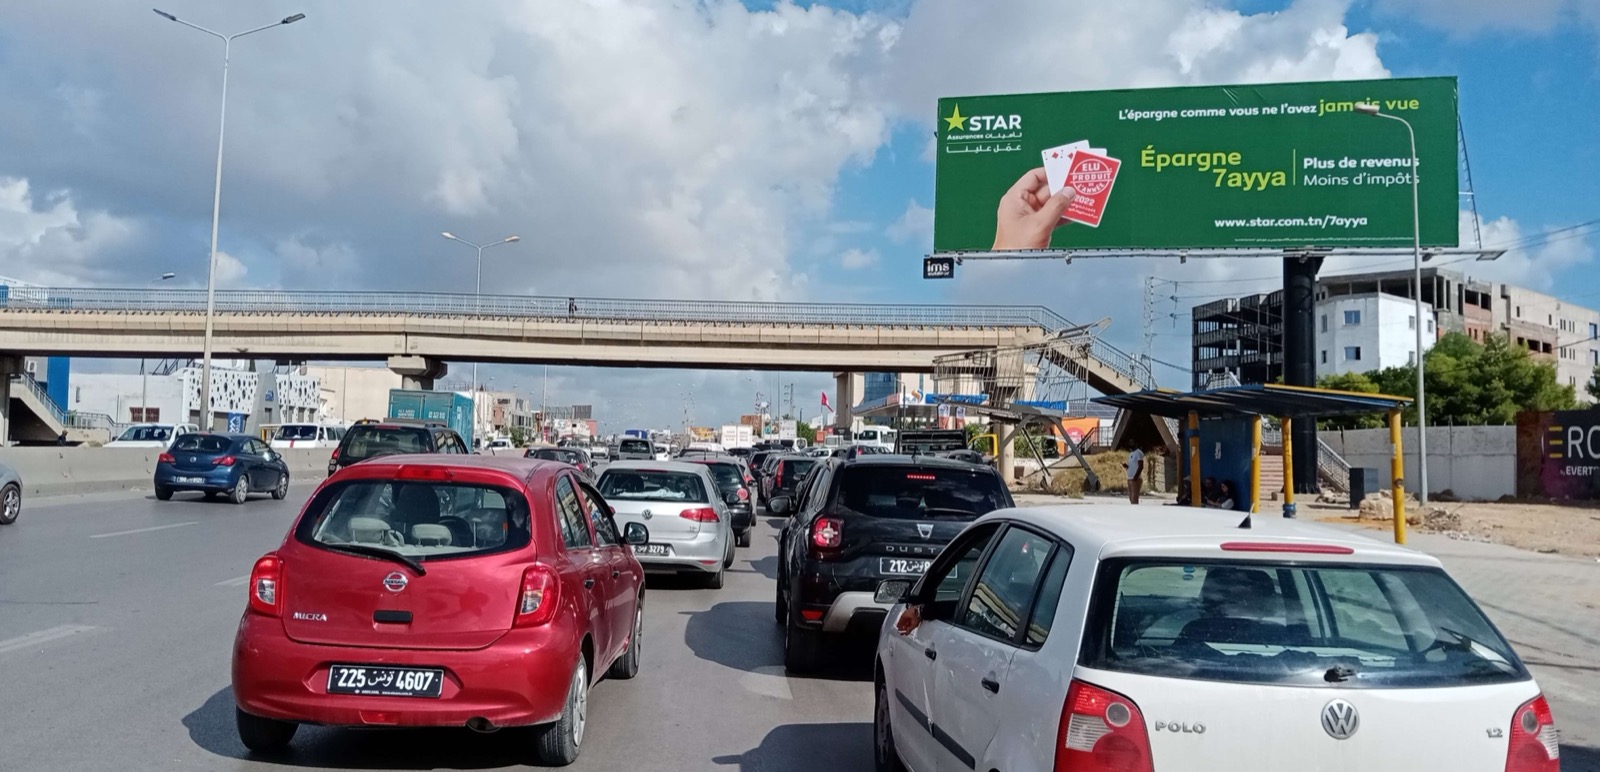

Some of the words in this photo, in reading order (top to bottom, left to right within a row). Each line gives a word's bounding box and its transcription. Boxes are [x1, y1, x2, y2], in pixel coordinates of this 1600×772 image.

[1119, 109, 1178, 121] L'épargne
[1180, 108, 1226, 117] comme
[1229, 107, 1259, 116] vous
[1262, 107, 1278, 115] ne
[1280, 103, 1317, 114] l'avez
[1385, 99, 1419, 110] vue
[969, 115, 1022, 131] STAR
[1141, 145, 1242, 172] Épargne
[1303, 157, 1335, 169] Plus
[1338, 156, 1357, 168] de
[1360, 158, 1420, 168] revenus
[1082, 162, 1100, 171] ELU
[1072, 172, 1111, 181] PRODUIT
[1212, 168, 1286, 191] 7ayya
[1303, 174, 1349, 186] Moins
[1353, 172, 1420, 187] d'impôts
[1074, 194, 1095, 206] 2022
[1214, 215, 1368, 229] www.star.com.tn/7ayya
[927, 260, 950, 272] ims
[889, 559, 907, 573] 212
[293, 611, 327, 621] MICRA
[338, 669, 366, 687] 225
[368, 670, 395, 687] تونس
[395, 671, 434, 691] 4607
[1155, 720, 1206, 734] POLO
